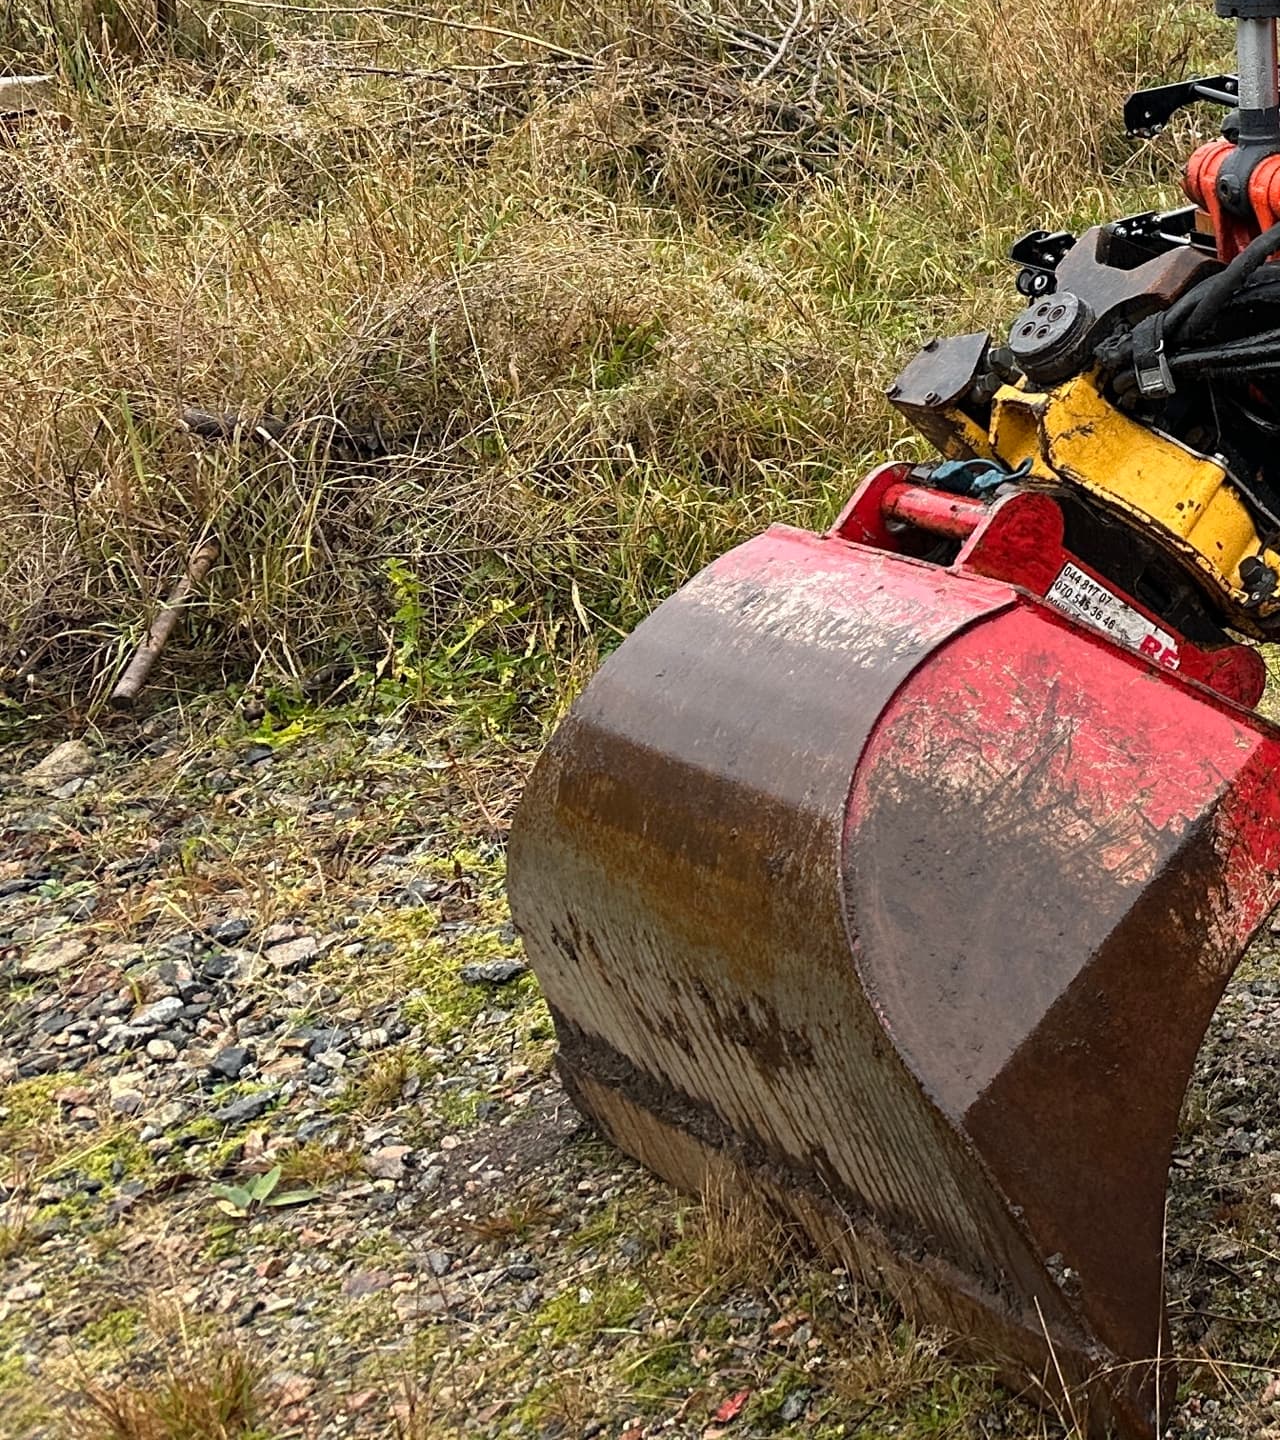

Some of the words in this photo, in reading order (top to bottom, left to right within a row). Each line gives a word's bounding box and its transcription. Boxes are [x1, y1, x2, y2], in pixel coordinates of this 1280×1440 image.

[1054, 580, 1073, 598] 070
[1090, 606, 1102, 621] 36
[1063, 566, 1082, 585] 044
[1080, 579, 1102, 597] 817
[1100, 592, 1113, 605] 07
